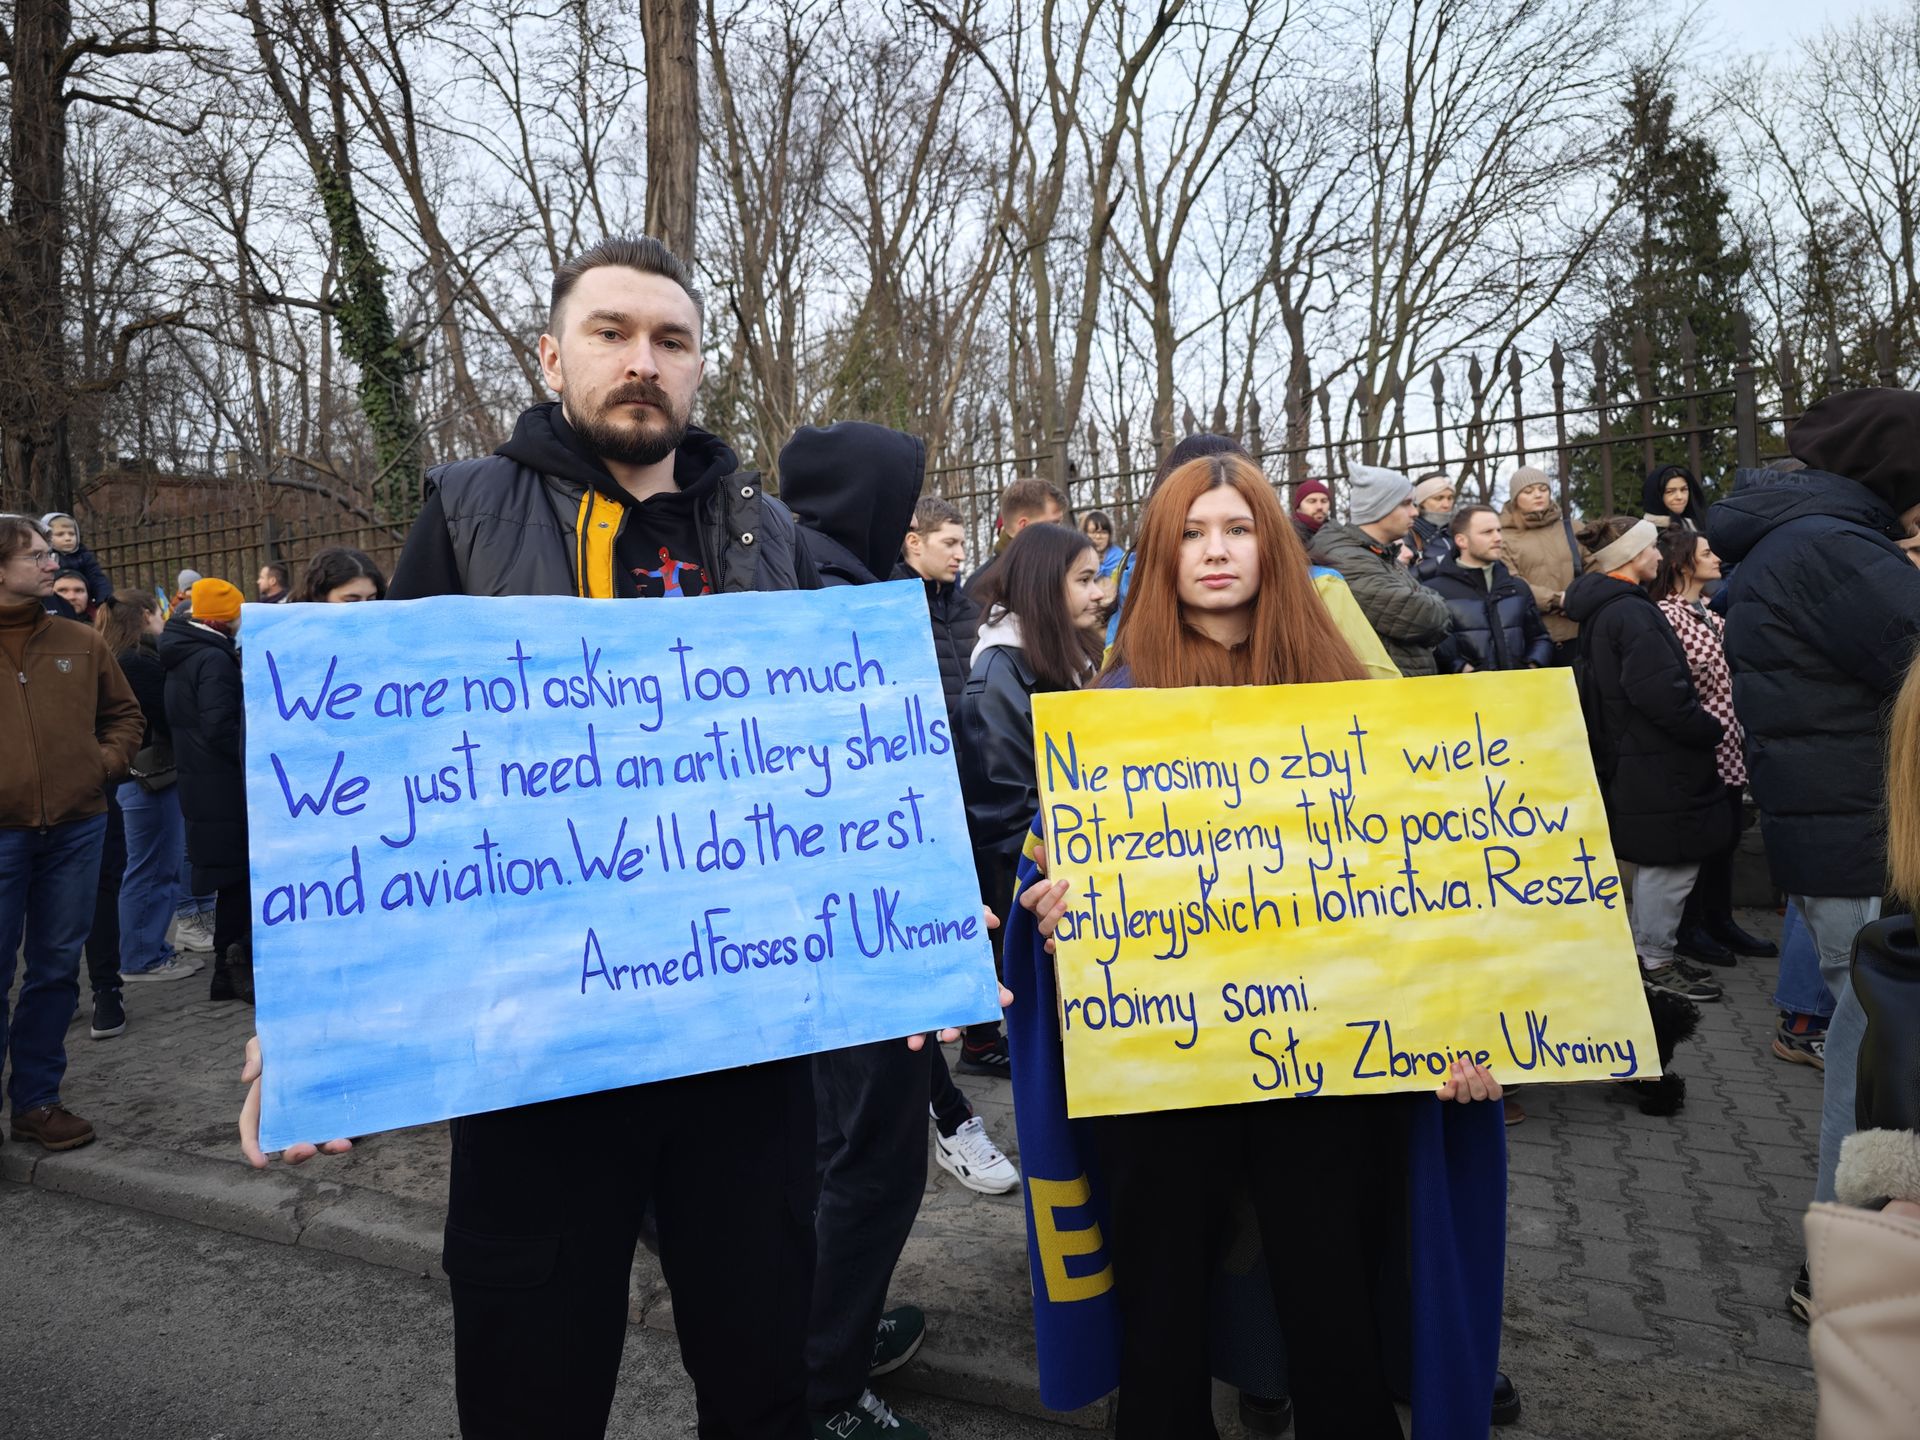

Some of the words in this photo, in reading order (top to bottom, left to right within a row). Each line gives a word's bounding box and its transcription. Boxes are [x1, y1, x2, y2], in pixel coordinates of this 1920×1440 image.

[266, 650, 363, 721] We
[373, 679, 449, 717] are
[463, 638, 533, 713] not
[668, 635, 750, 702] too
[765, 630, 897, 696] much.
[270, 750, 371, 818] We
[379, 730, 481, 848] just
[500, 722, 602, 798] need
[615, 752, 666, 790] an
[673, 714, 832, 799] artillery
[845, 693, 951, 772] shells
[1044, 731, 1109, 793] Nie
[1122, 755, 1241, 819] prosimy
[1249, 756, 1270, 785] o
[1280, 713, 1370, 801] zbyt
[1402, 711, 1526, 775] wiele.
[262, 845, 365, 926] and
[380, 828, 572, 912] aviation.
[567, 809, 686, 884] We'll
[695, 808, 747, 875] do
[744, 801, 825, 866] the
[838, 785, 936, 855] rest.
[1051, 801, 1284, 885] Potrzebujemy
[1292, 892, 1301, 927] i
[1308, 855, 1484, 923] lotnictwa.
[1483, 837, 1620, 911] Resztę
[582, 927, 704, 994] Armed
[703, 906, 800, 976] Forses
[803, 891, 841, 964] of
[1063, 963, 1200, 1050] robimy
[1221, 975, 1318, 1024] sami.
[1028, 1171, 1115, 1303] E
